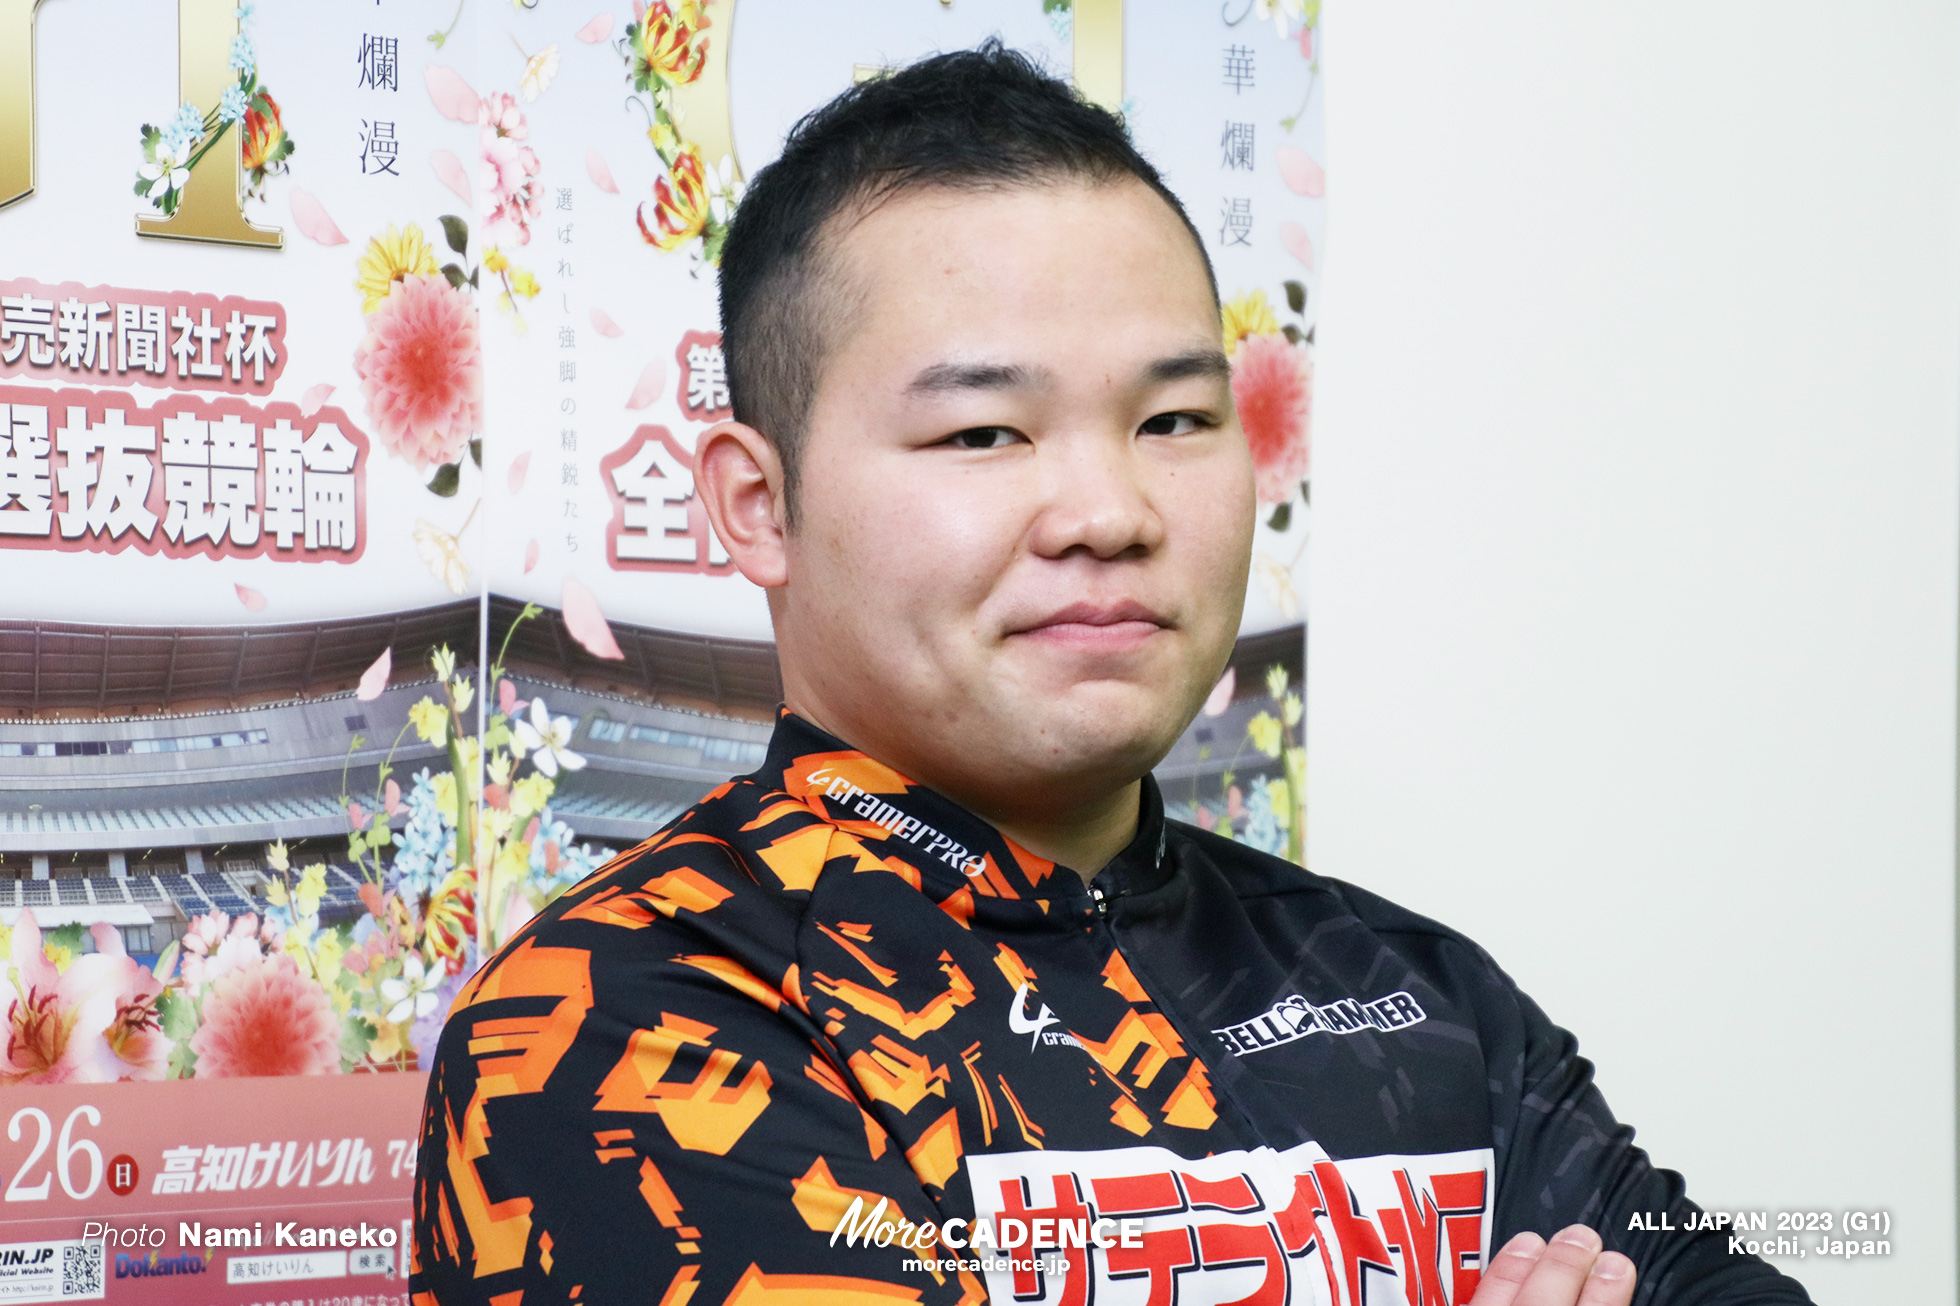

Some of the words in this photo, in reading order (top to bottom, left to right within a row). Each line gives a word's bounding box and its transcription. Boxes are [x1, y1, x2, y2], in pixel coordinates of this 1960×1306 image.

[357, 0, 400, 177] 爛漫
[555, 187, 580, 553] 選ばれし強脚の精鋭たち
[1216, 1014, 1294, 1055] BELL
[4, 1104, 104, 1200] 26
[151, 1138, 376, 1195] 高知けいりん
[0, 1248, 54, 1266] IN.JP
[232, 1257, 314, 1279] 高知けいりん
[358, 1253, 387, 1269] 検索
